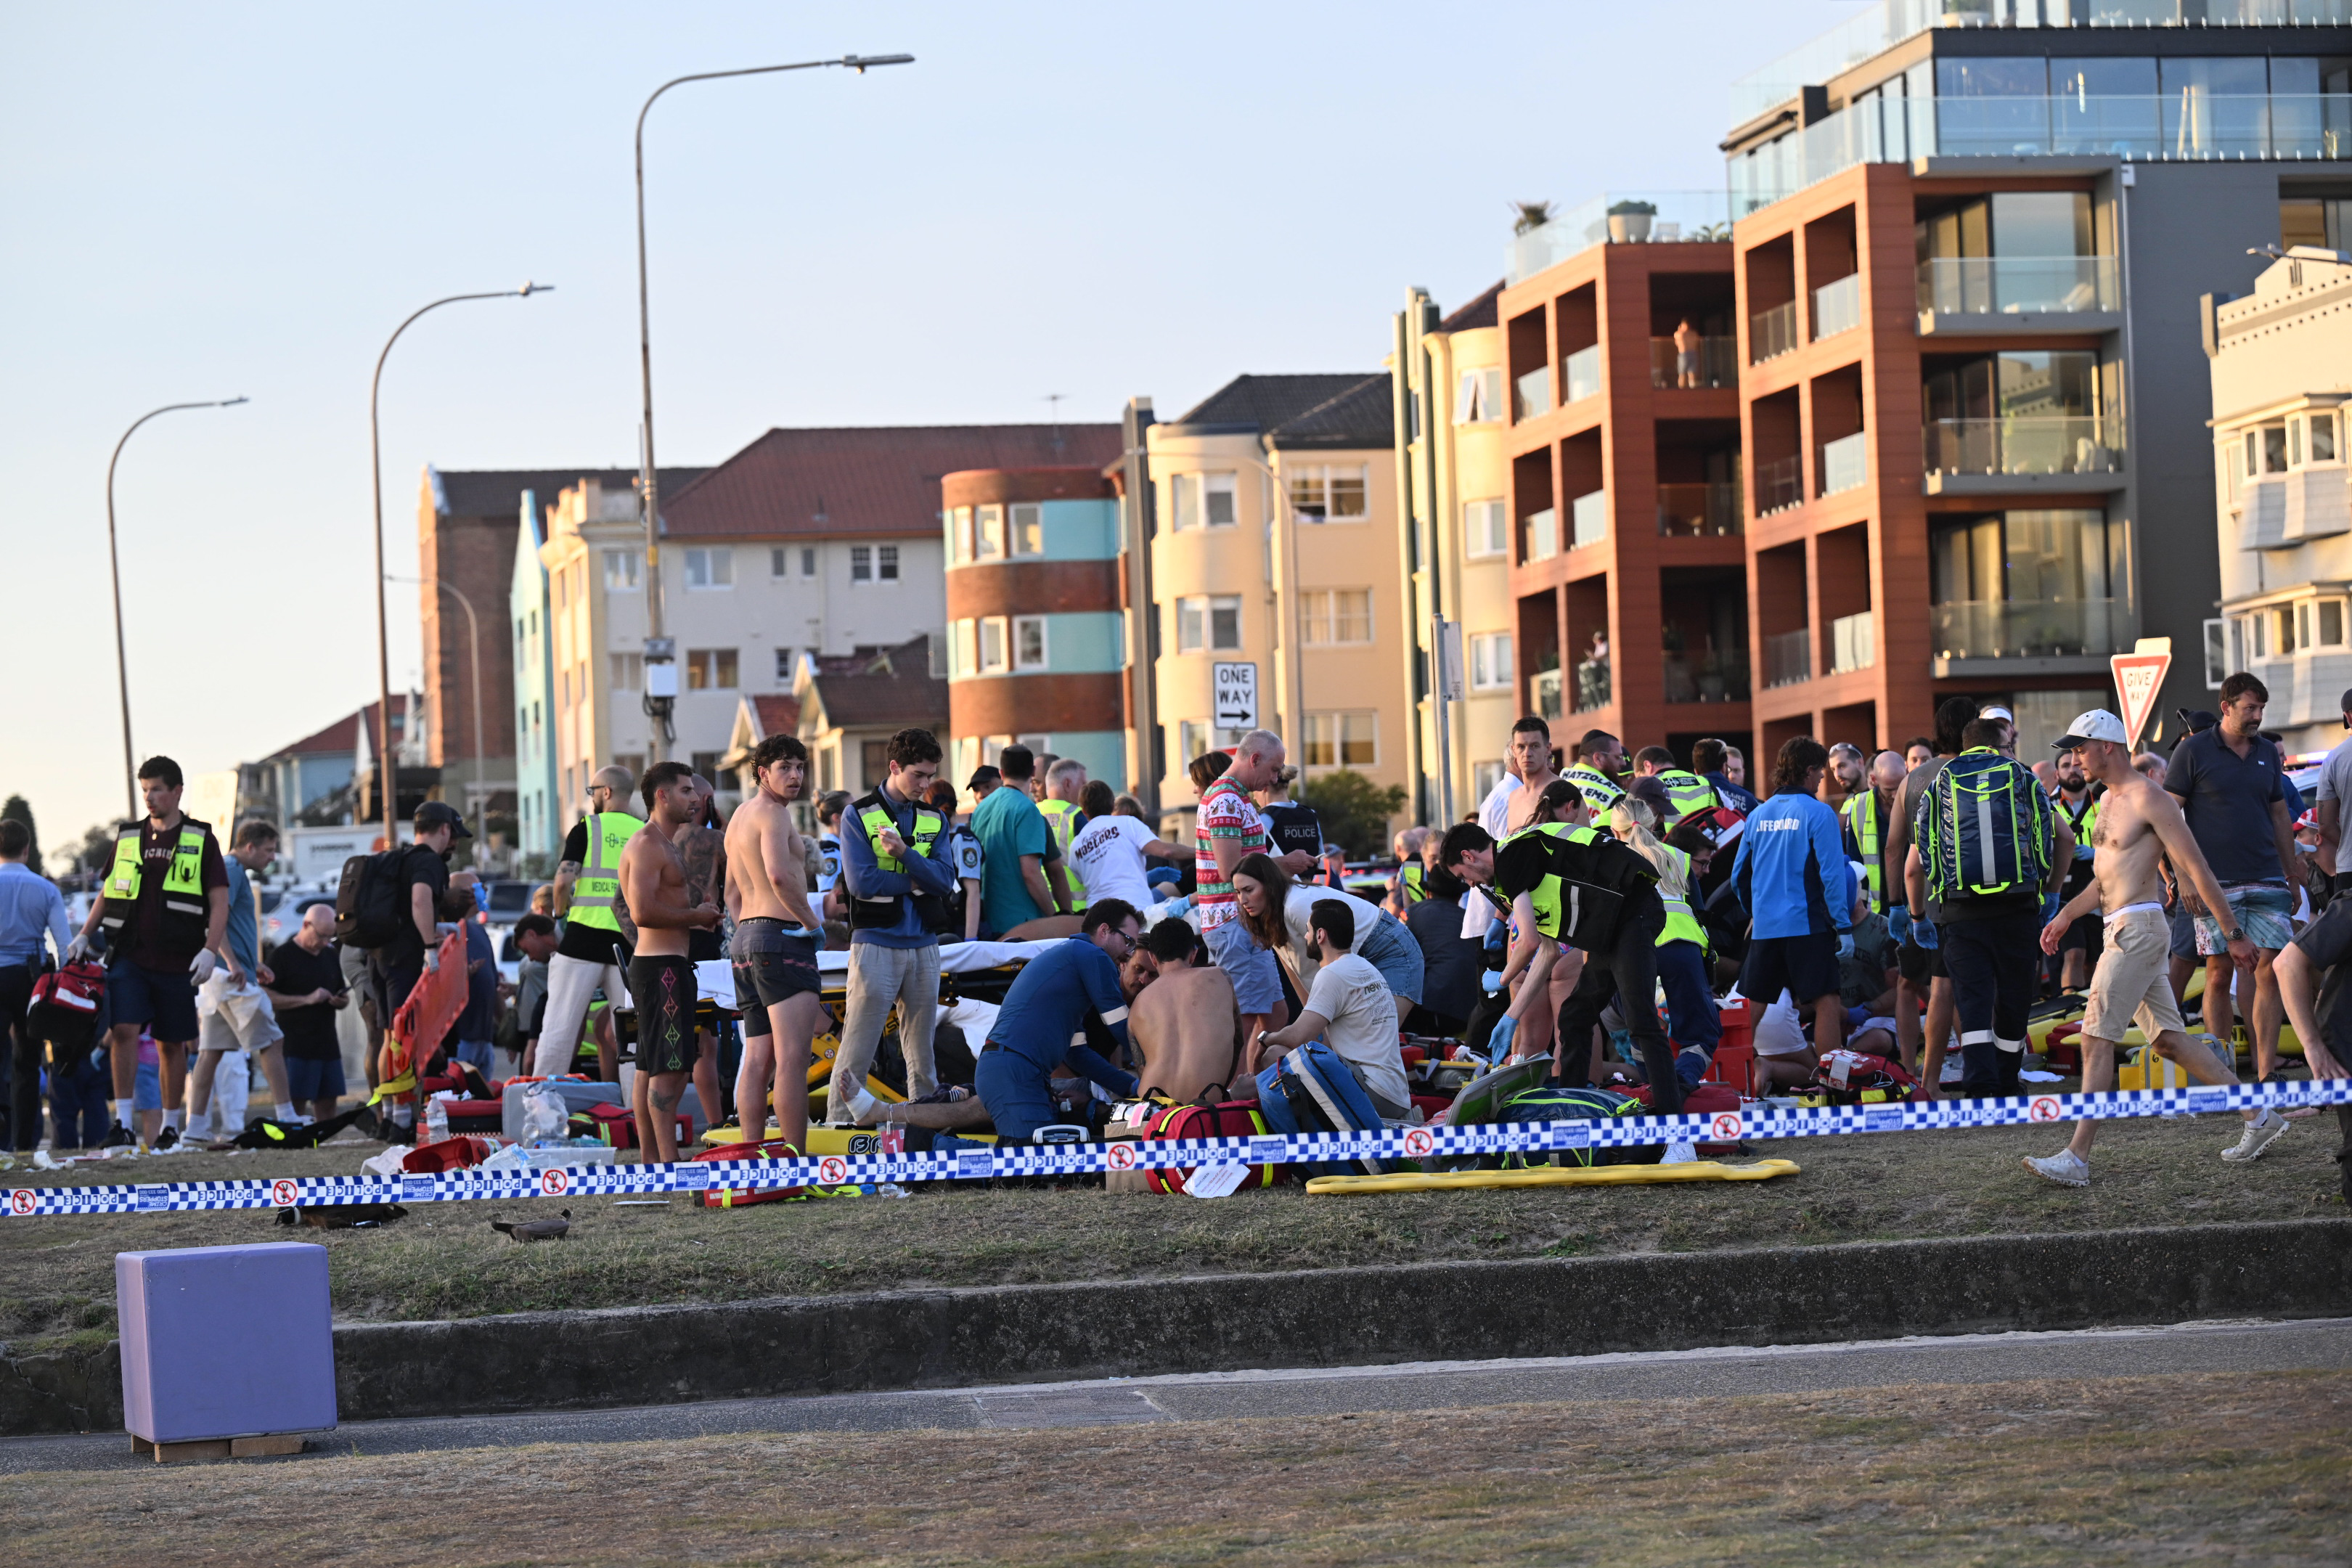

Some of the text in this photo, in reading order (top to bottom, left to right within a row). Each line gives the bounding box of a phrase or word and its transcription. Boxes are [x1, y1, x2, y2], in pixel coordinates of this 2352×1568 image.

[1220, 669, 1249, 684] ONE
[2127, 672, 2151, 687] GIVE
[1218, 690, 1252, 704] WAY
[2130, 691, 2145, 702] WAY
[1585, 788, 1609, 803] EMS
[1284, 828, 1316, 838] POLICE
[592, 881, 611, 892] MEDICAL
[1364, 980, 1382, 995] new
[2152, 1053, 2160, 1063] 6
[2266, 1092, 2331, 1105] POLICE
[2096, 1101, 2162, 1114] POLICE
[1940, 1110, 2004, 1122] POLICE
[1776, 1118, 1839, 1130] POLICE
[1625, 1126, 1689, 1138] POLICE
[889, 1138, 898, 1154] 1
[1466, 1134, 1528, 1146] POLICE
[1320, 1141, 1381, 1153] POLICE
[1026, 1154, 1085, 1166] POLICE
[1167, 1149, 1227, 1160] POLICE
[740, 1167, 797, 1178] POLICE
[879, 1161, 935, 1173] POLICE
[465, 1179, 520, 1191] POLICE
[598, 1173, 654, 1185] POLICE
[199, 1189, 252, 1201] POLICE
[328, 1184, 380, 1196] POLICE
[65, 1193, 116, 1205] POLICE
